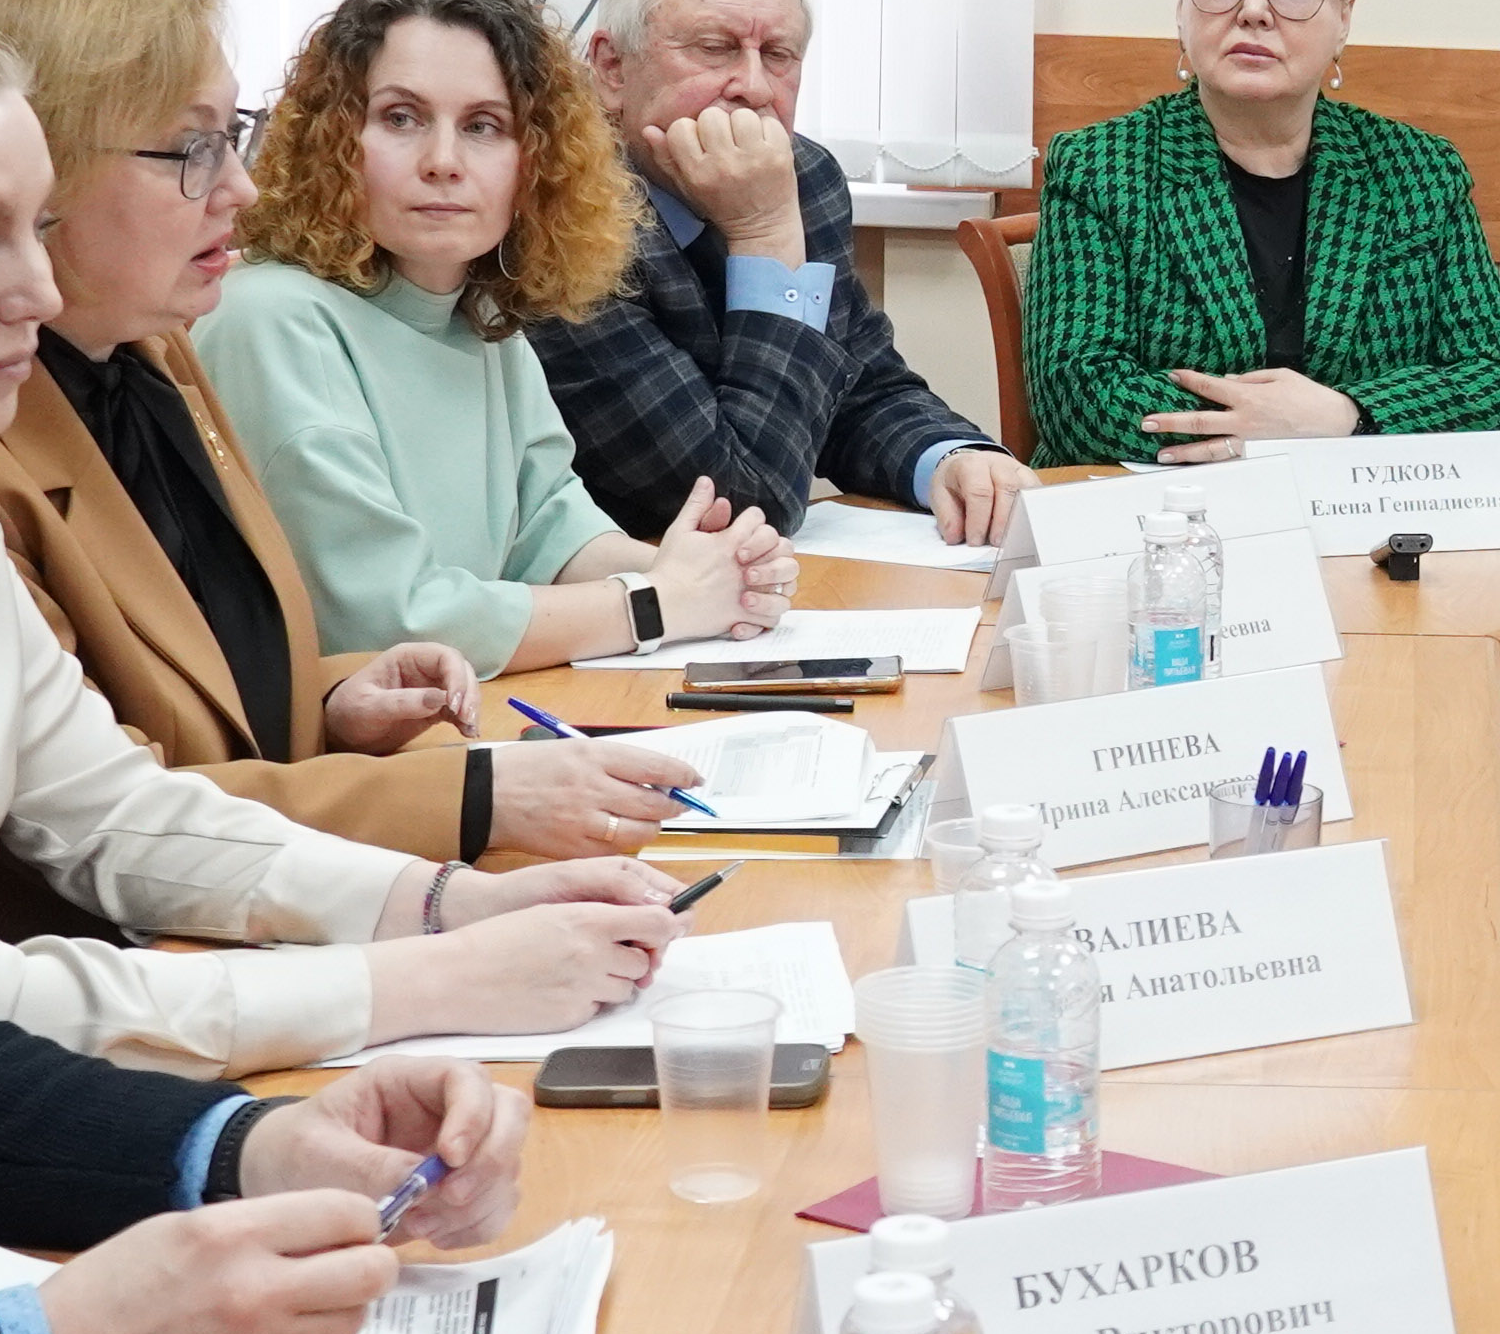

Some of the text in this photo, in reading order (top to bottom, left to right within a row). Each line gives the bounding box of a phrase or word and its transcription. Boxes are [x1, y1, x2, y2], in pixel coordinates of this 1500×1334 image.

[1351, 463, 1462, 485] ГУДКОВА
[1310, 498, 1372, 517] Елена
[1092, 732, 1221, 772] ГРИНЕВА
[1073, 909, 1244, 954] ВАЛИЕВА
[1126, 951, 1323, 1000] Анатольевна
[1012, 1237, 1261, 1311] БУХАРКОВ
